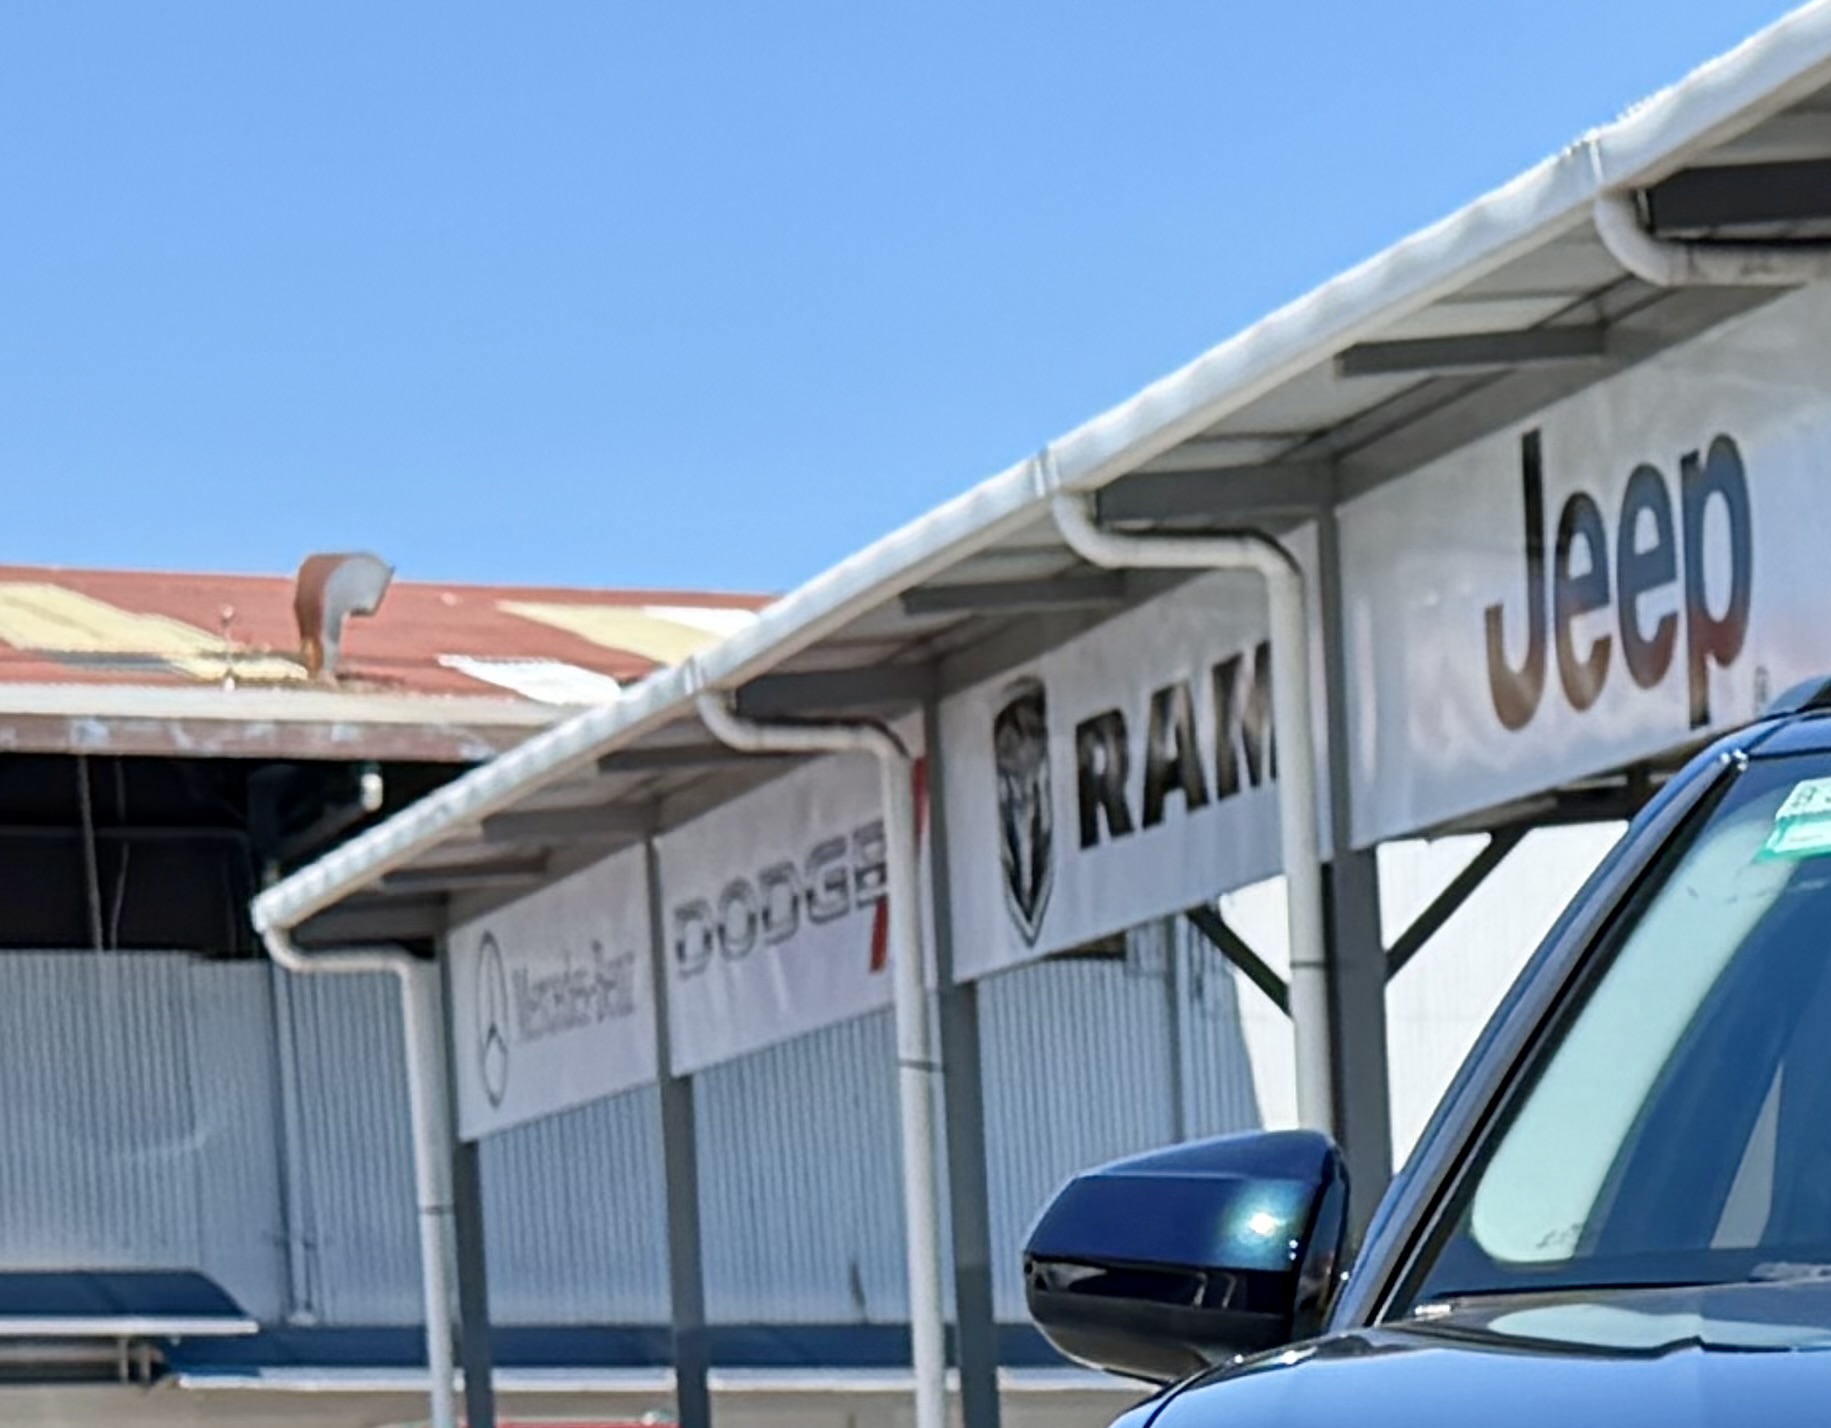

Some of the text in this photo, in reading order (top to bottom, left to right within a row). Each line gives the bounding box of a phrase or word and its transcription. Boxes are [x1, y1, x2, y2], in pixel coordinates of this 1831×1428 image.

[1484, 427, 1753, 733] Jeep
[1075, 639, 1277, 852] RAM
[674, 817, 888, 978] DODGE
